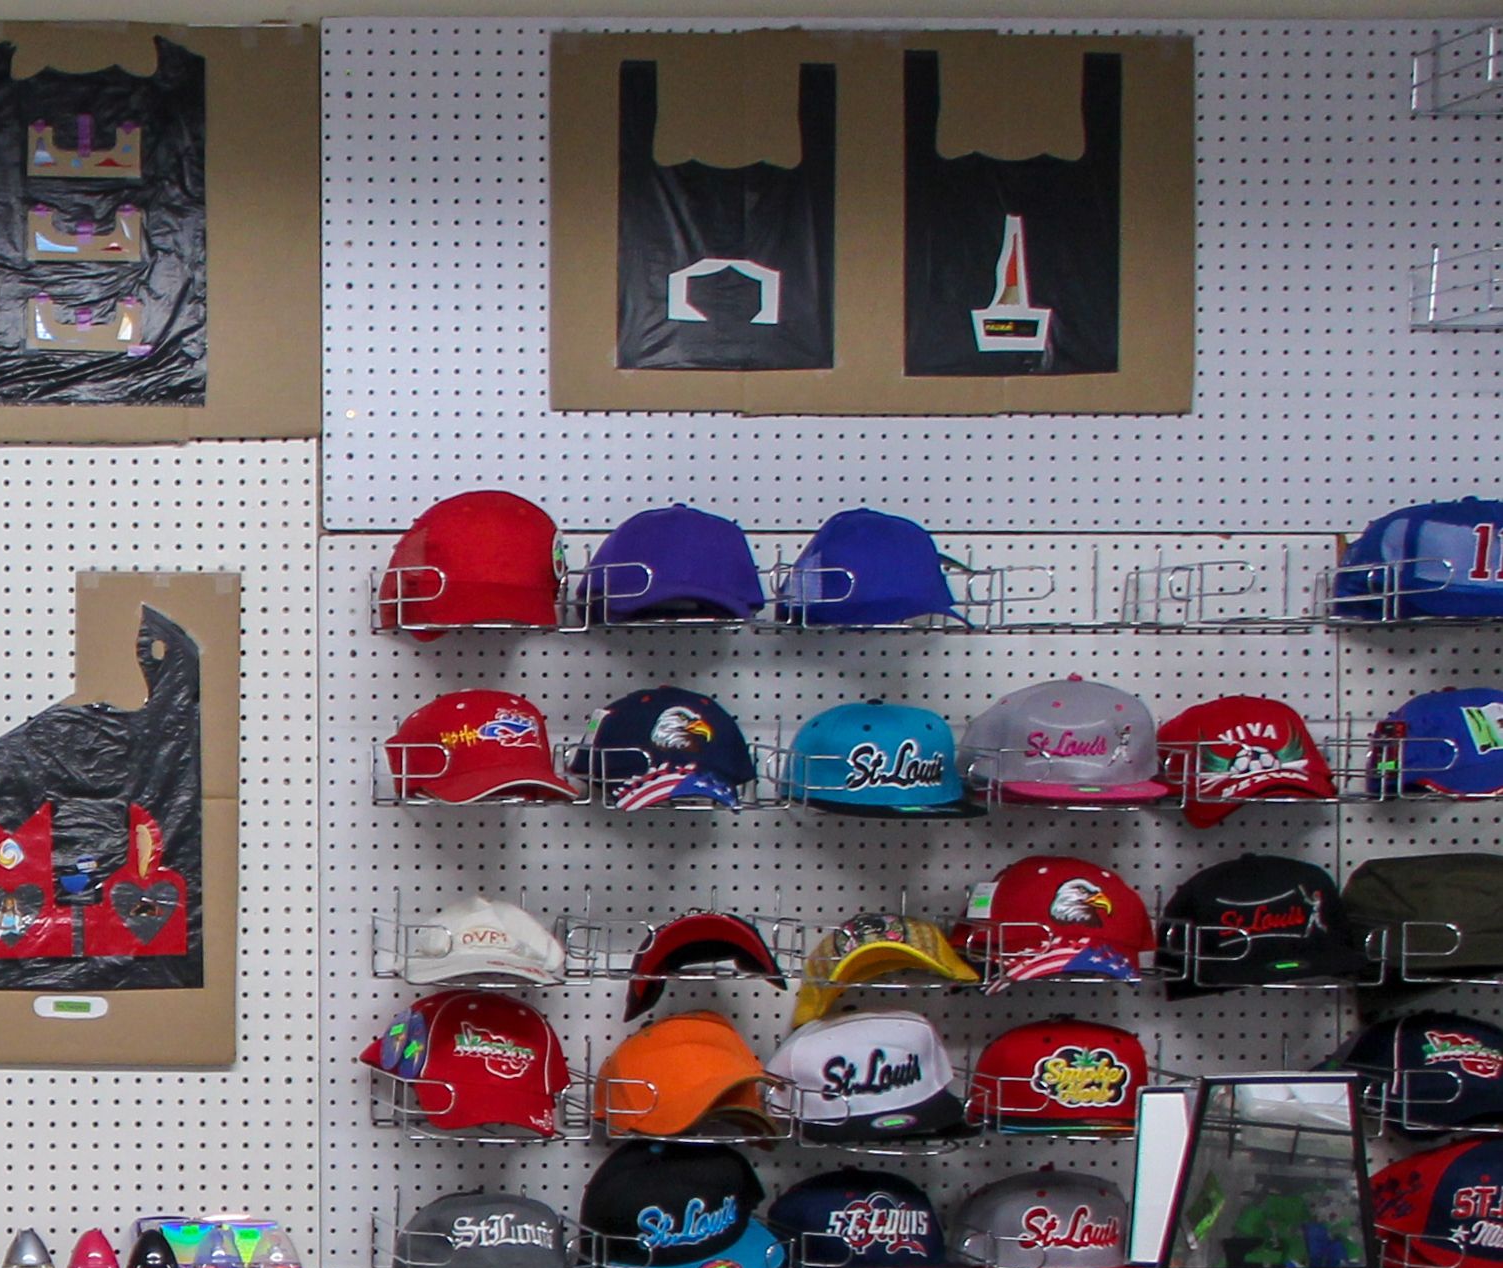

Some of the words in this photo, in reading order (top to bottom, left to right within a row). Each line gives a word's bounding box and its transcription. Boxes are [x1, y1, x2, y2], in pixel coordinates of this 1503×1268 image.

[1051, 730, 1107, 757] Louis
[1218, 722, 1277, 745] VIVA
[887, 740, 944, 788] Louis
[1243, 905, 1305, 935] Louis
[859, 1048, 922, 1094] Louis
[1045, 1059, 1124, 1084] Smoke
[487, 1213, 555, 1249] Louis
[677, 1196, 739, 1245] Louis
[1060, 1205, 1119, 1250] Louis
